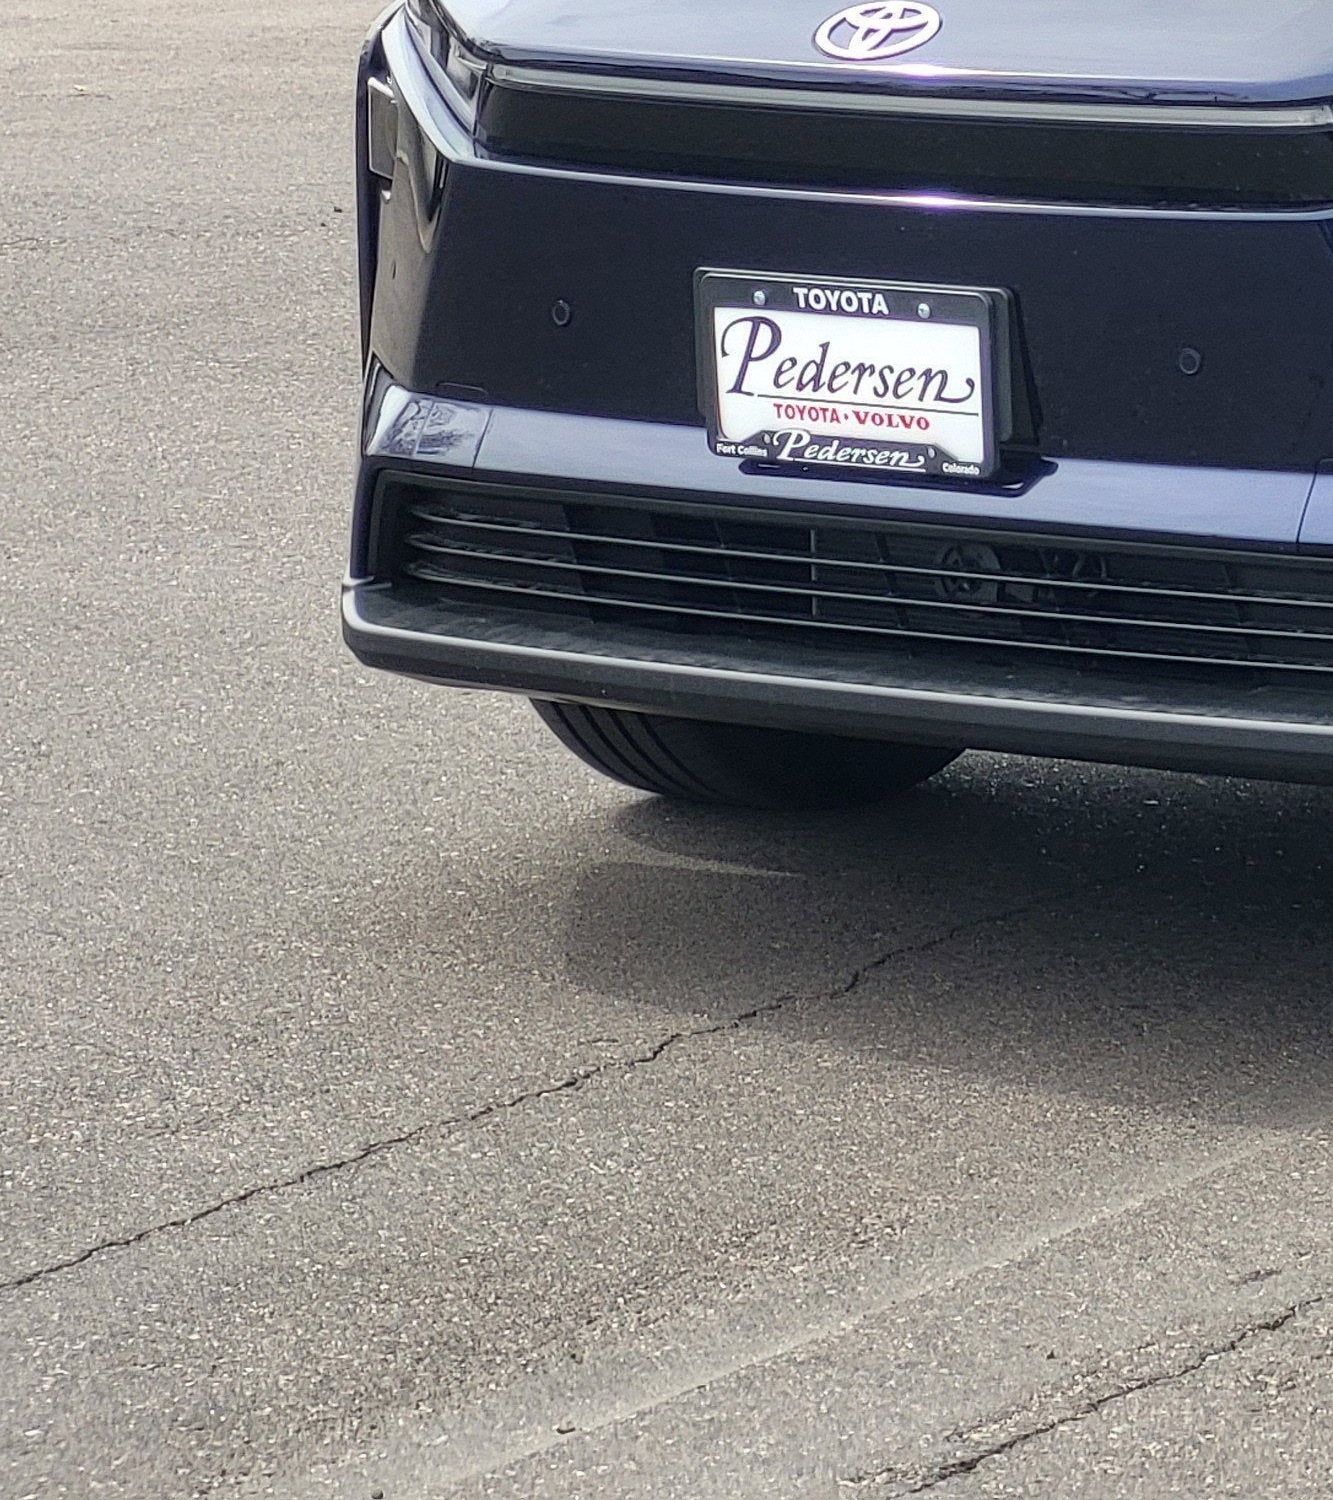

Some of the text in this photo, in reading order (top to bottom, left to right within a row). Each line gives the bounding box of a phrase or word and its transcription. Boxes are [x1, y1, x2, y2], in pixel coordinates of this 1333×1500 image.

[793, 286, 890, 316] TOYOTA
[721, 315, 976, 404] Pedersen
[773, 403, 930, 431] TOYOTA VOLVO
[773, 428, 926, 468] Pedersen
